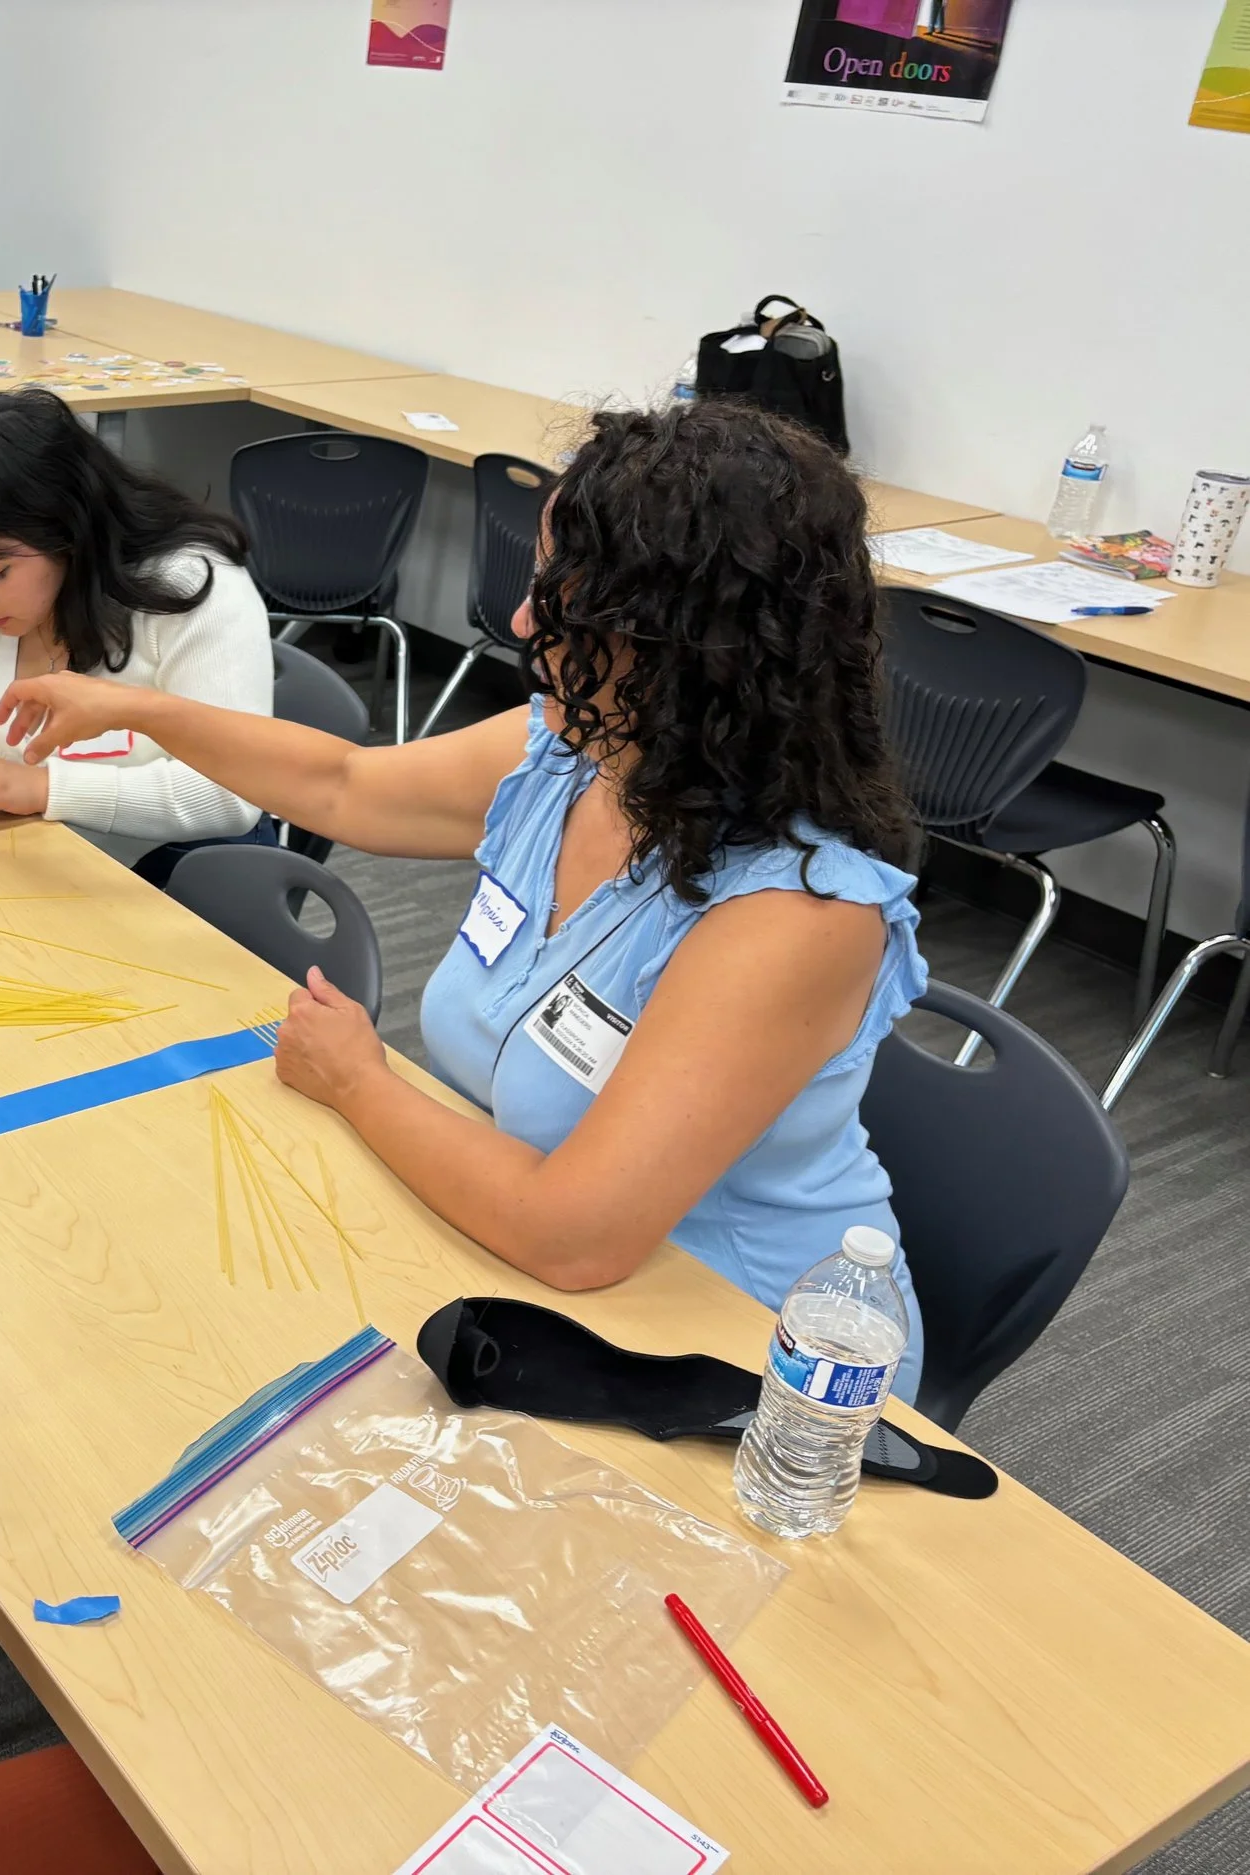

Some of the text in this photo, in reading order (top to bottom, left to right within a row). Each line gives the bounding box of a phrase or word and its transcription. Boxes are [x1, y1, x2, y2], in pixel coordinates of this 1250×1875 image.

[823, 47, 952, 82] Open doors
[606, 1013, 630, 1032] VISITOR
[307, 1534, 357, 1572] Ziploc
